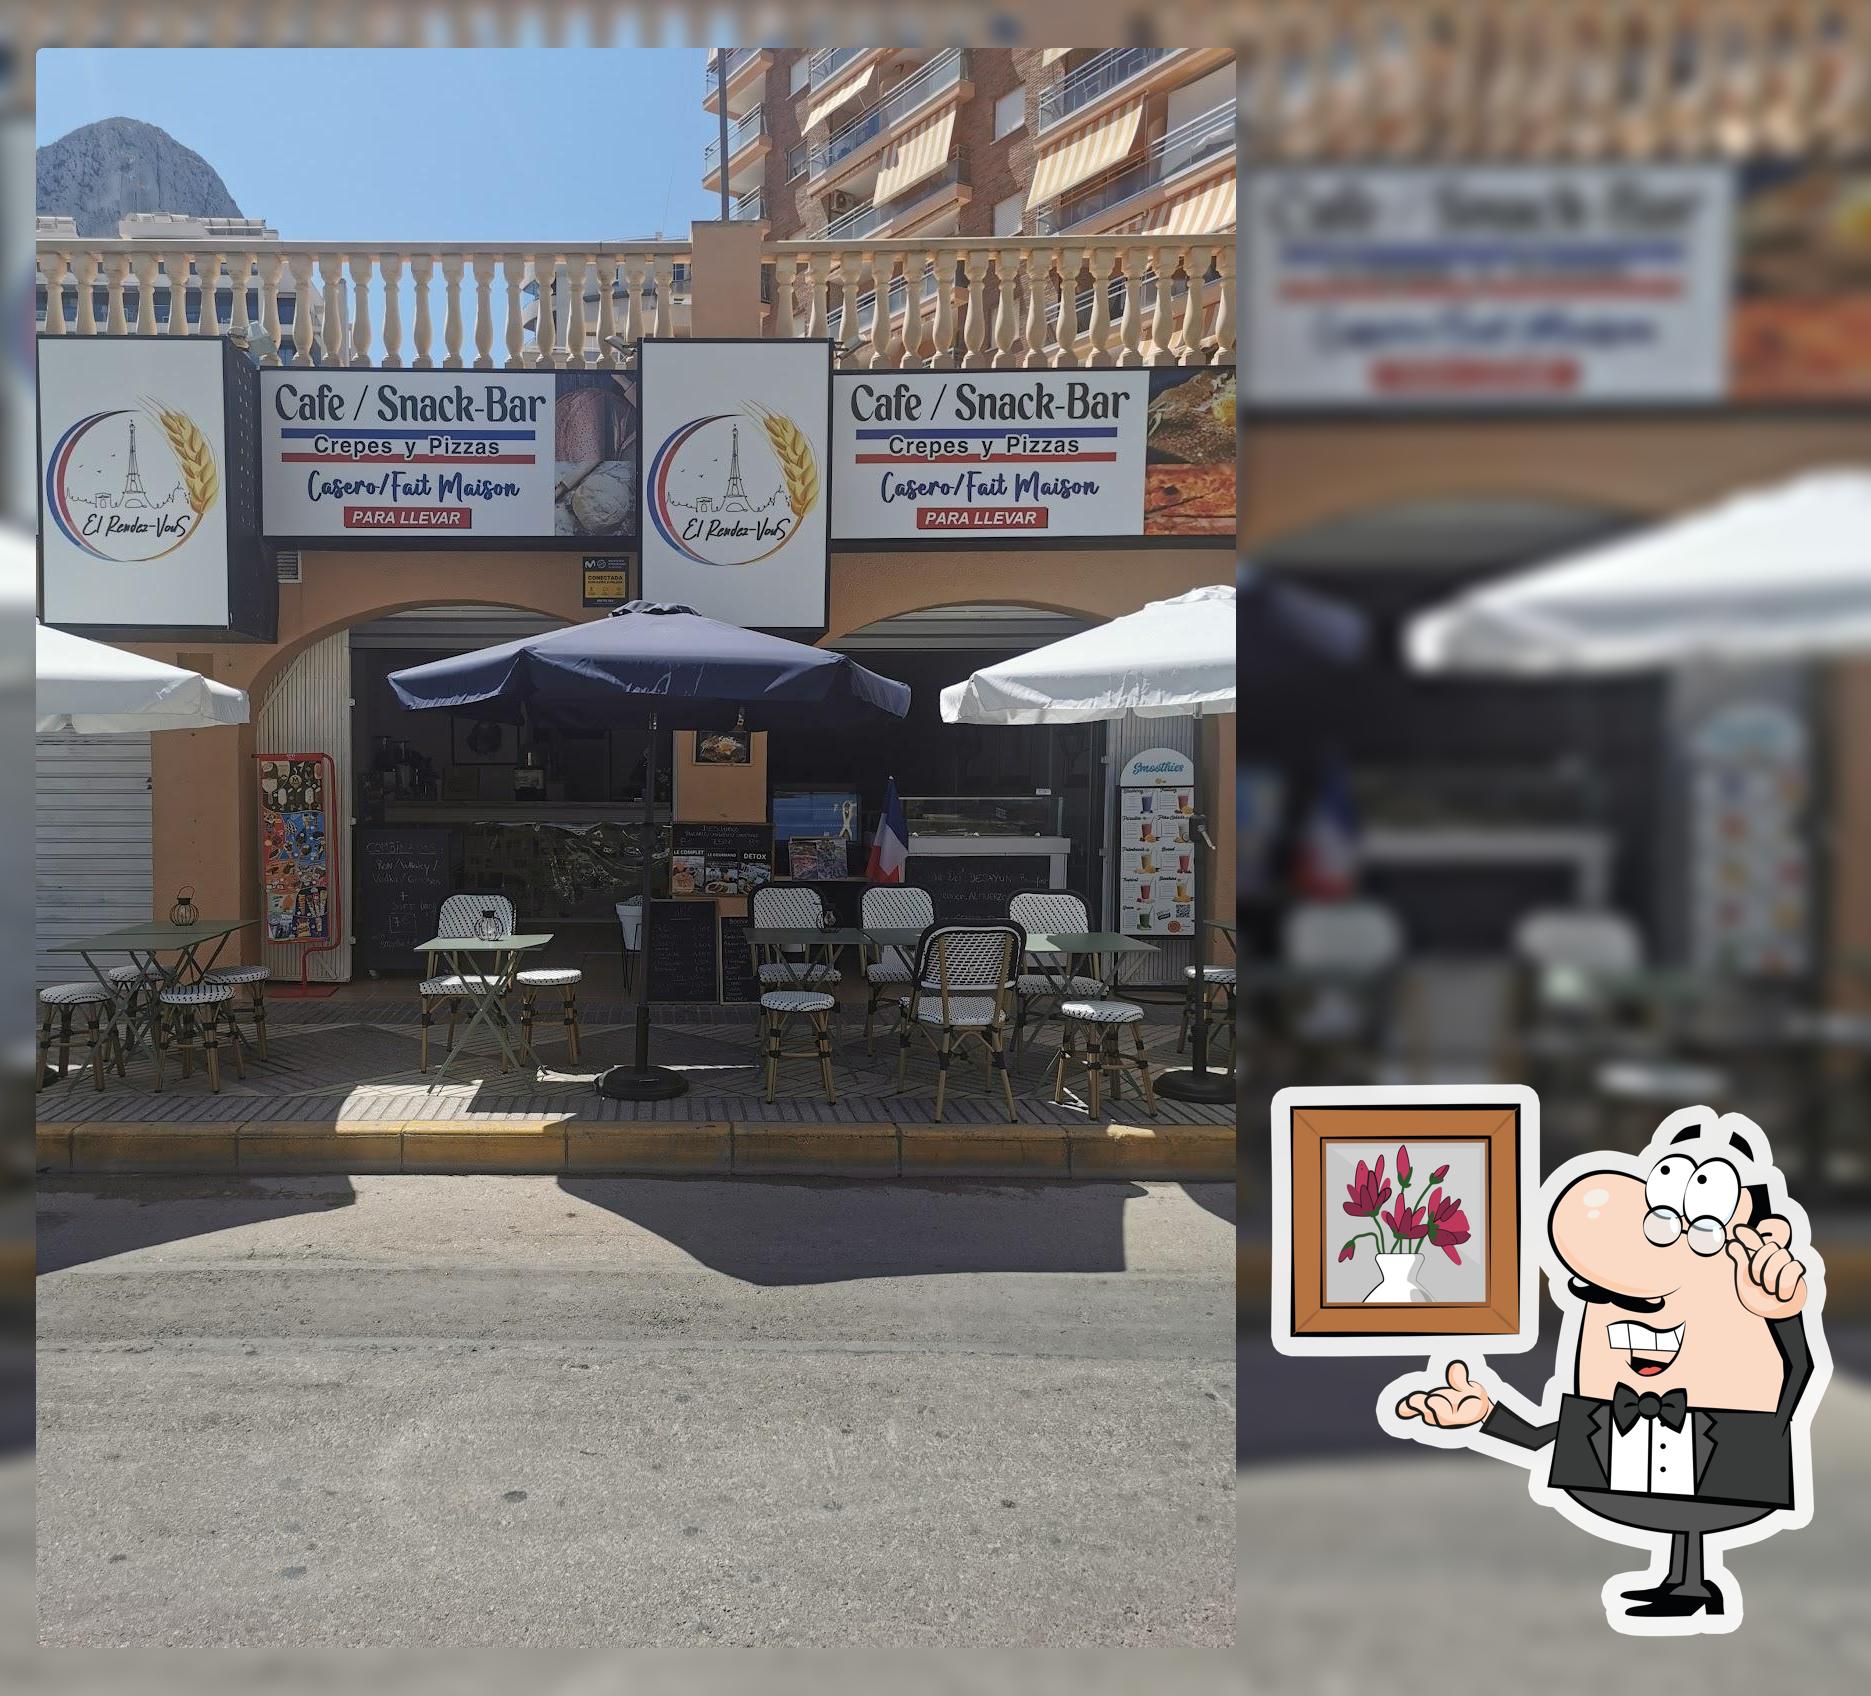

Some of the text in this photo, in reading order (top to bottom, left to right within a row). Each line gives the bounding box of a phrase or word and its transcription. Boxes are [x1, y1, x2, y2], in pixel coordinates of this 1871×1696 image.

[275, 384, 547, 422] Cafe / Snack-Bar
[850, 382, 1131, 422] Cafe / Snack-Bar
[314, 436, 500, 459] Crepes y Pizzas
[888, 434, 1080, 459] Crepes y Pizzas
[438, 471, 521, 504] Maison
[1014, 471, 1100, 503] Maison
[82, 514, 103, 536] El
[352, 511, 461, 525] PARA LLEVAR
[682, 518, 704, 541] El
[925, 511, 1037, 526] PARA LLEVAR
[1132, 762, 1185, 775] Smoothies
